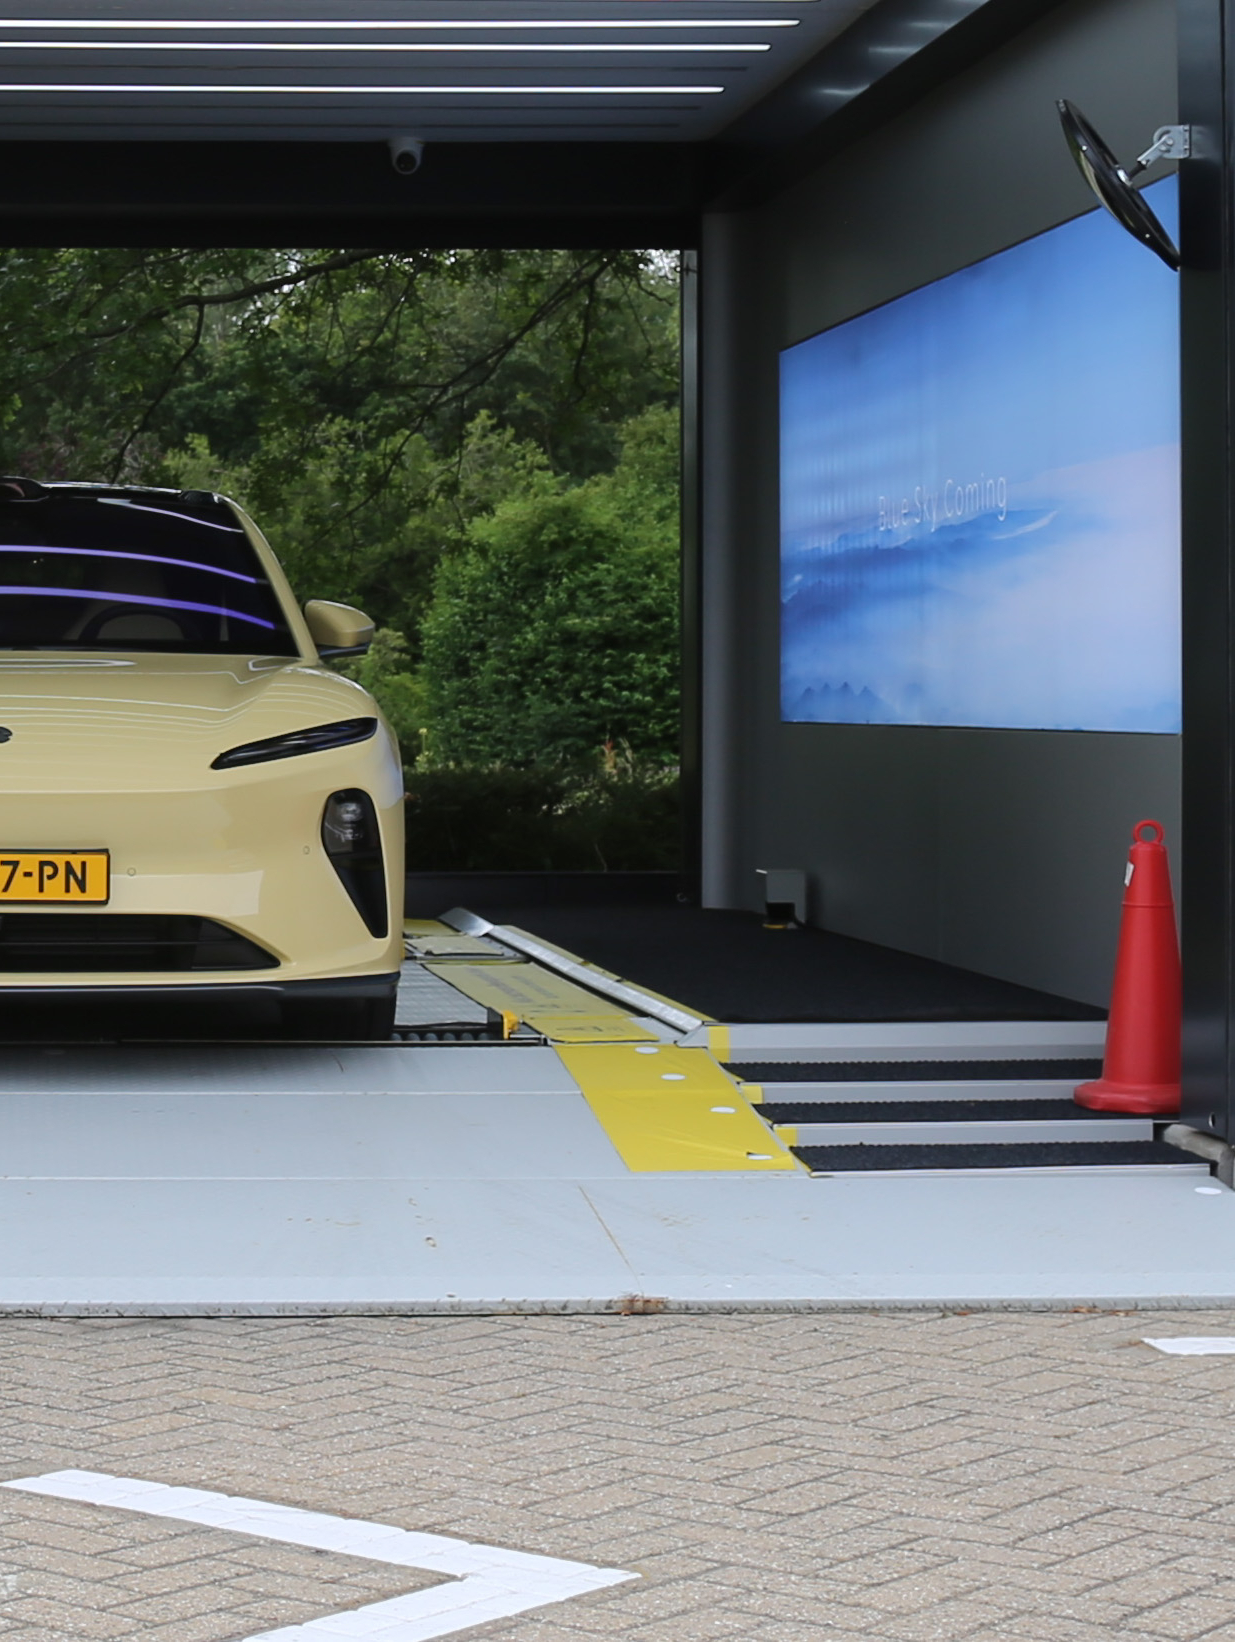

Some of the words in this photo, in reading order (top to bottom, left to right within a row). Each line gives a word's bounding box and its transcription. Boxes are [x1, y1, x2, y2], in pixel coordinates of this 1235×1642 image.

[878, 495, 909, 532] Blue
[913, 484, 939, 533] Sky
[944, 472, 1007, 522] Coming
